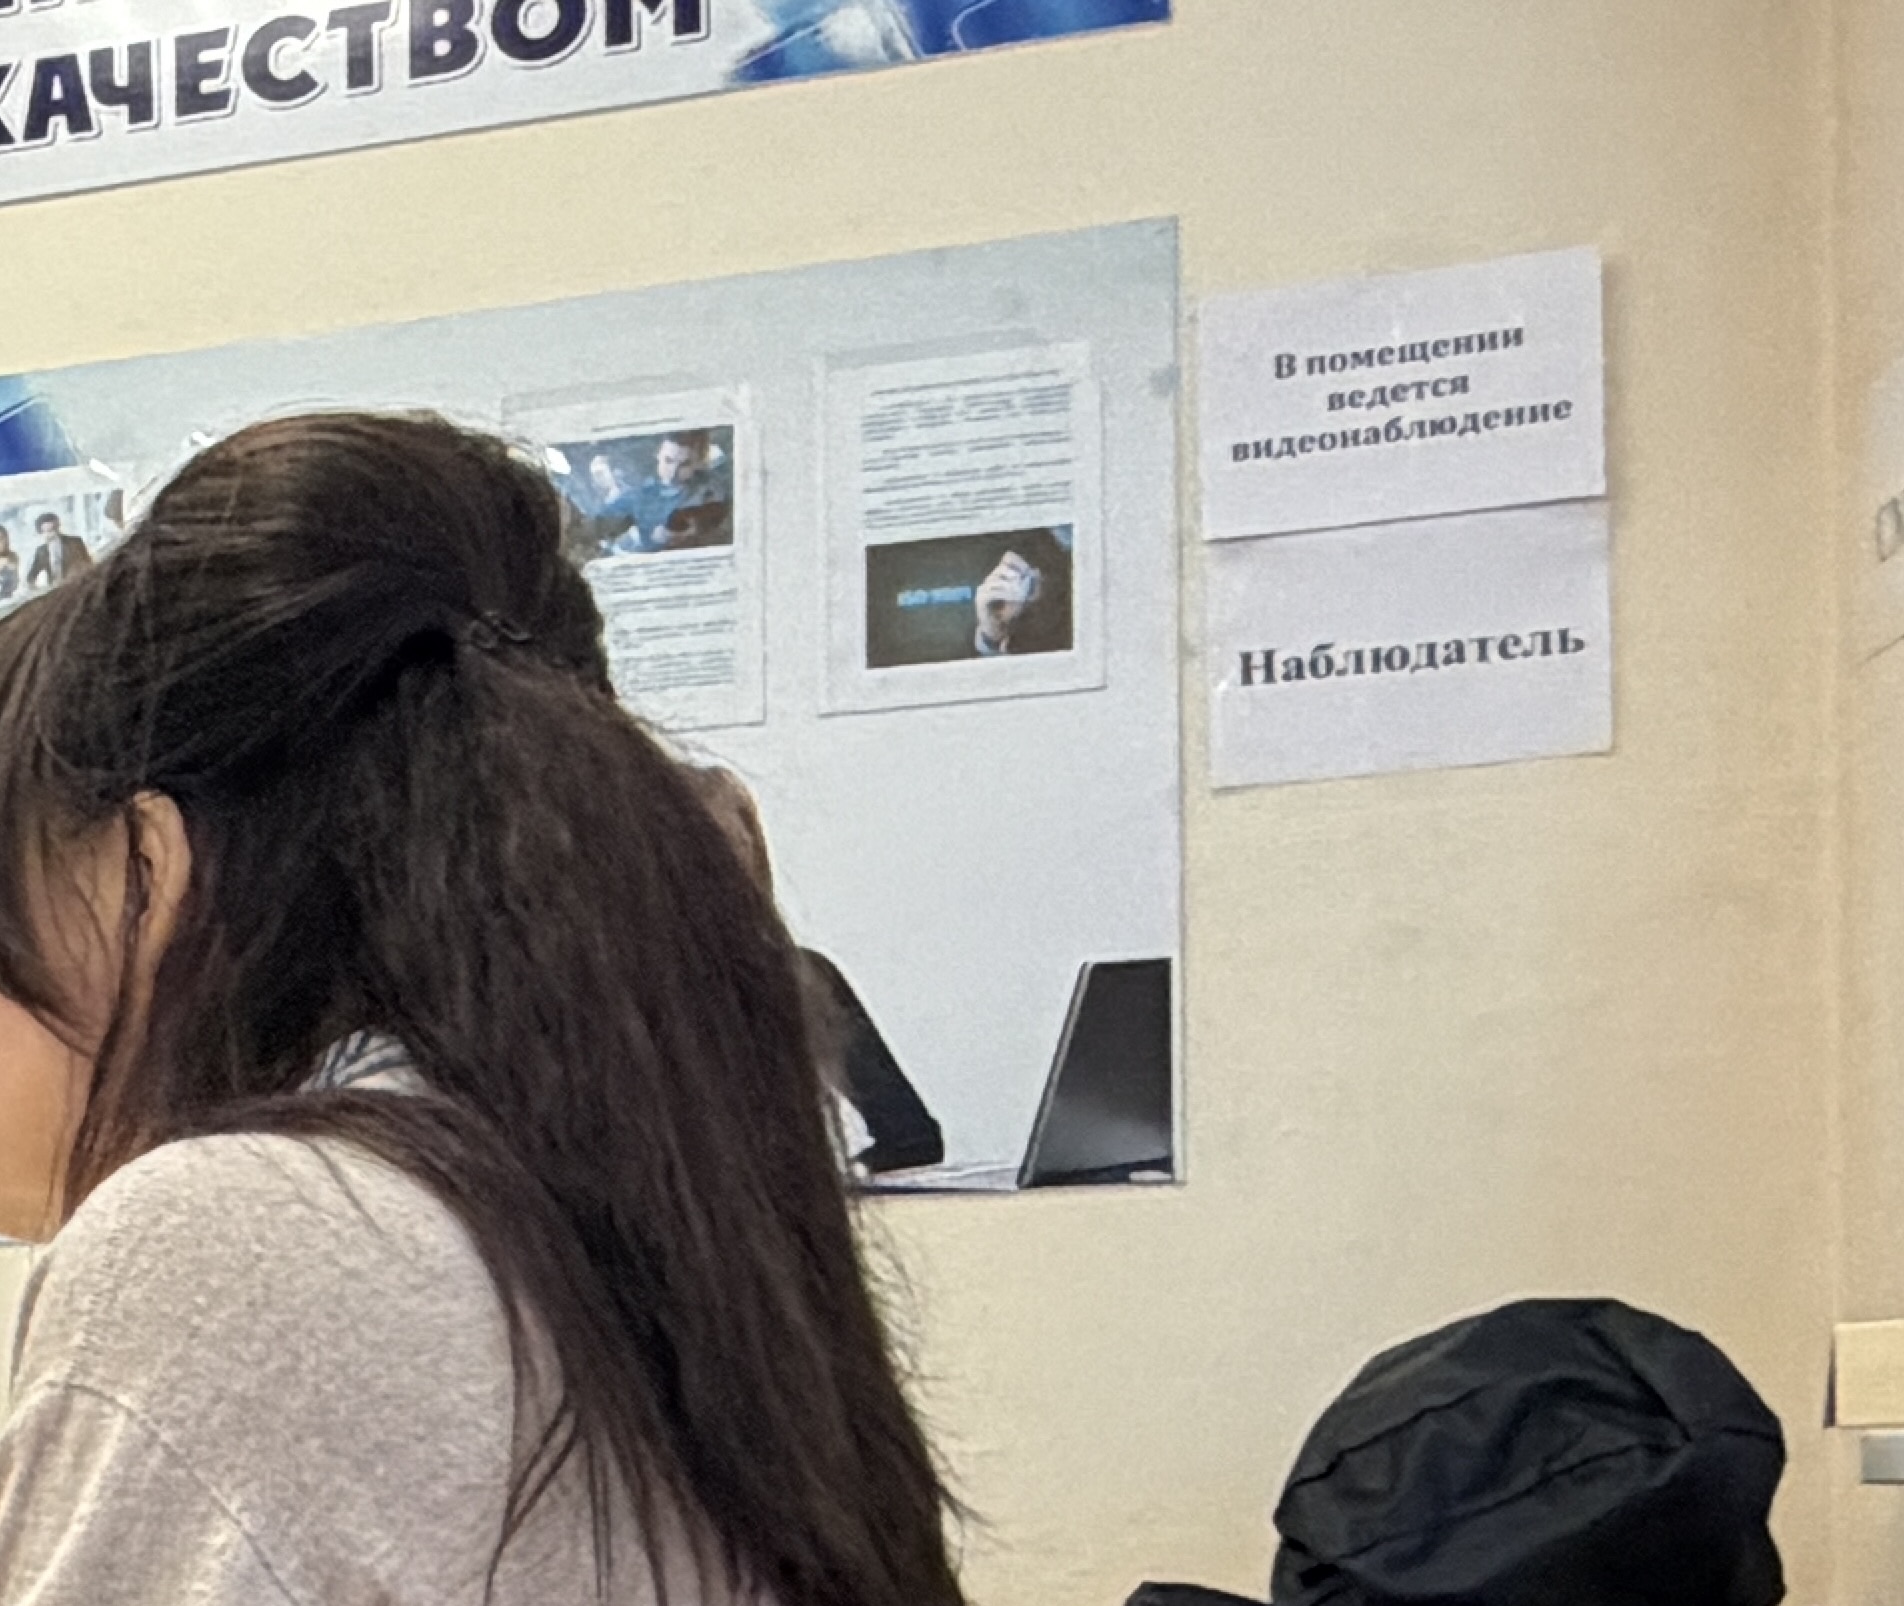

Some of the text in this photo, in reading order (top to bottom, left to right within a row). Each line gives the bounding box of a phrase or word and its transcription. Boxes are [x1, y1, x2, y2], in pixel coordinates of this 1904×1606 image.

[1274, 326, 1525, 380] В помещении
[1326, 374, 1470, 412] ведется
[1231, 399, 1574, 463] видеонаблюдение
[1239, 627, 1586, 687] Наблюдатель
